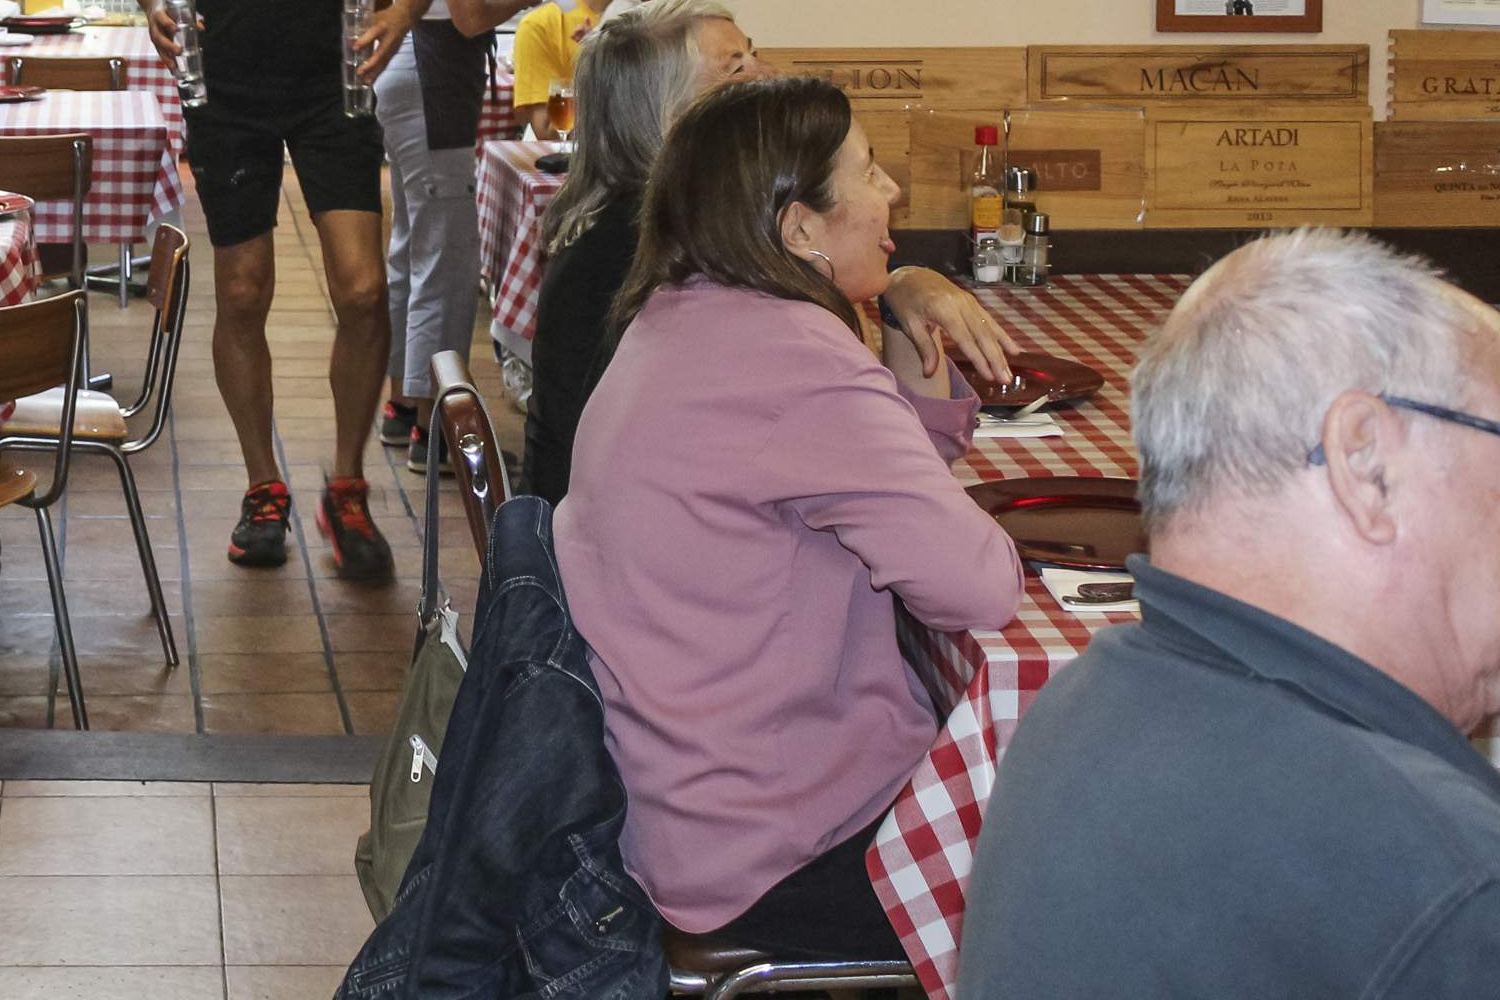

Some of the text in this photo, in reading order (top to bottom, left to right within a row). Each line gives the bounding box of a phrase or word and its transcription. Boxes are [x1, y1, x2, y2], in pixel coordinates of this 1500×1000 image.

[1423, 77, 1500, 94] GRAT
[1216, 128, 1299, 146] ARTADI
[1220, 160, 1297, 172] LA POZA
[1434, 183, 1475, 193] QUINTA
